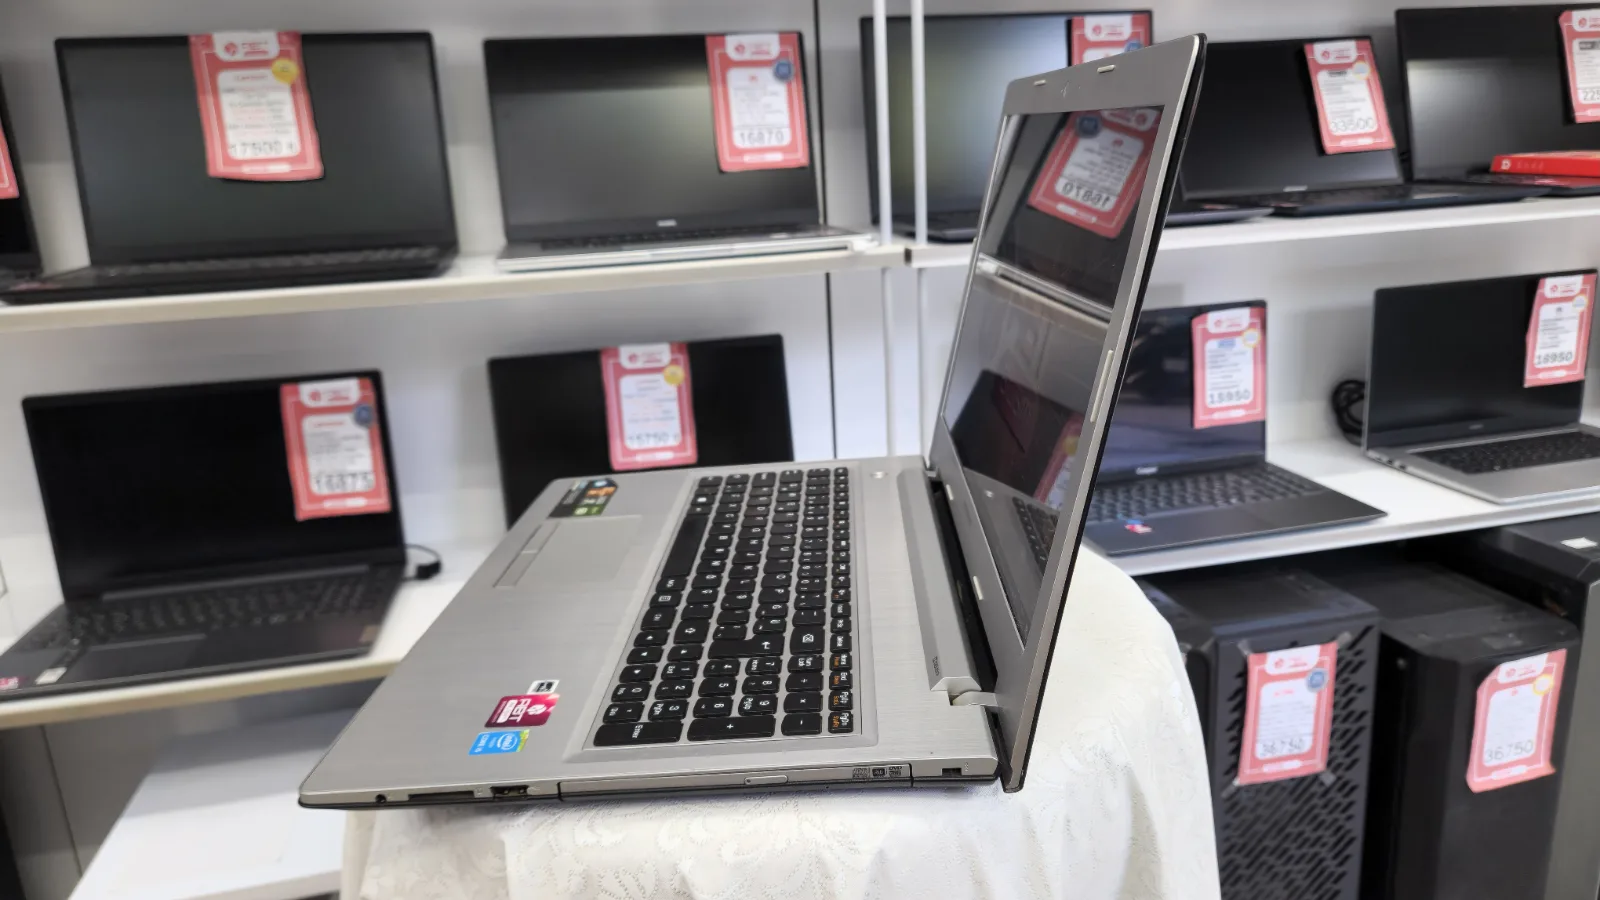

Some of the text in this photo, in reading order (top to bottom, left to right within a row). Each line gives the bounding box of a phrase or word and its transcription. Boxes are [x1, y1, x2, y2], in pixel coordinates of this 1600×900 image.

[1330, 116, 1375, 133] 33500
[739, 130, 785, 146] 16870
[1485, 740, 1534, 763] 36750
